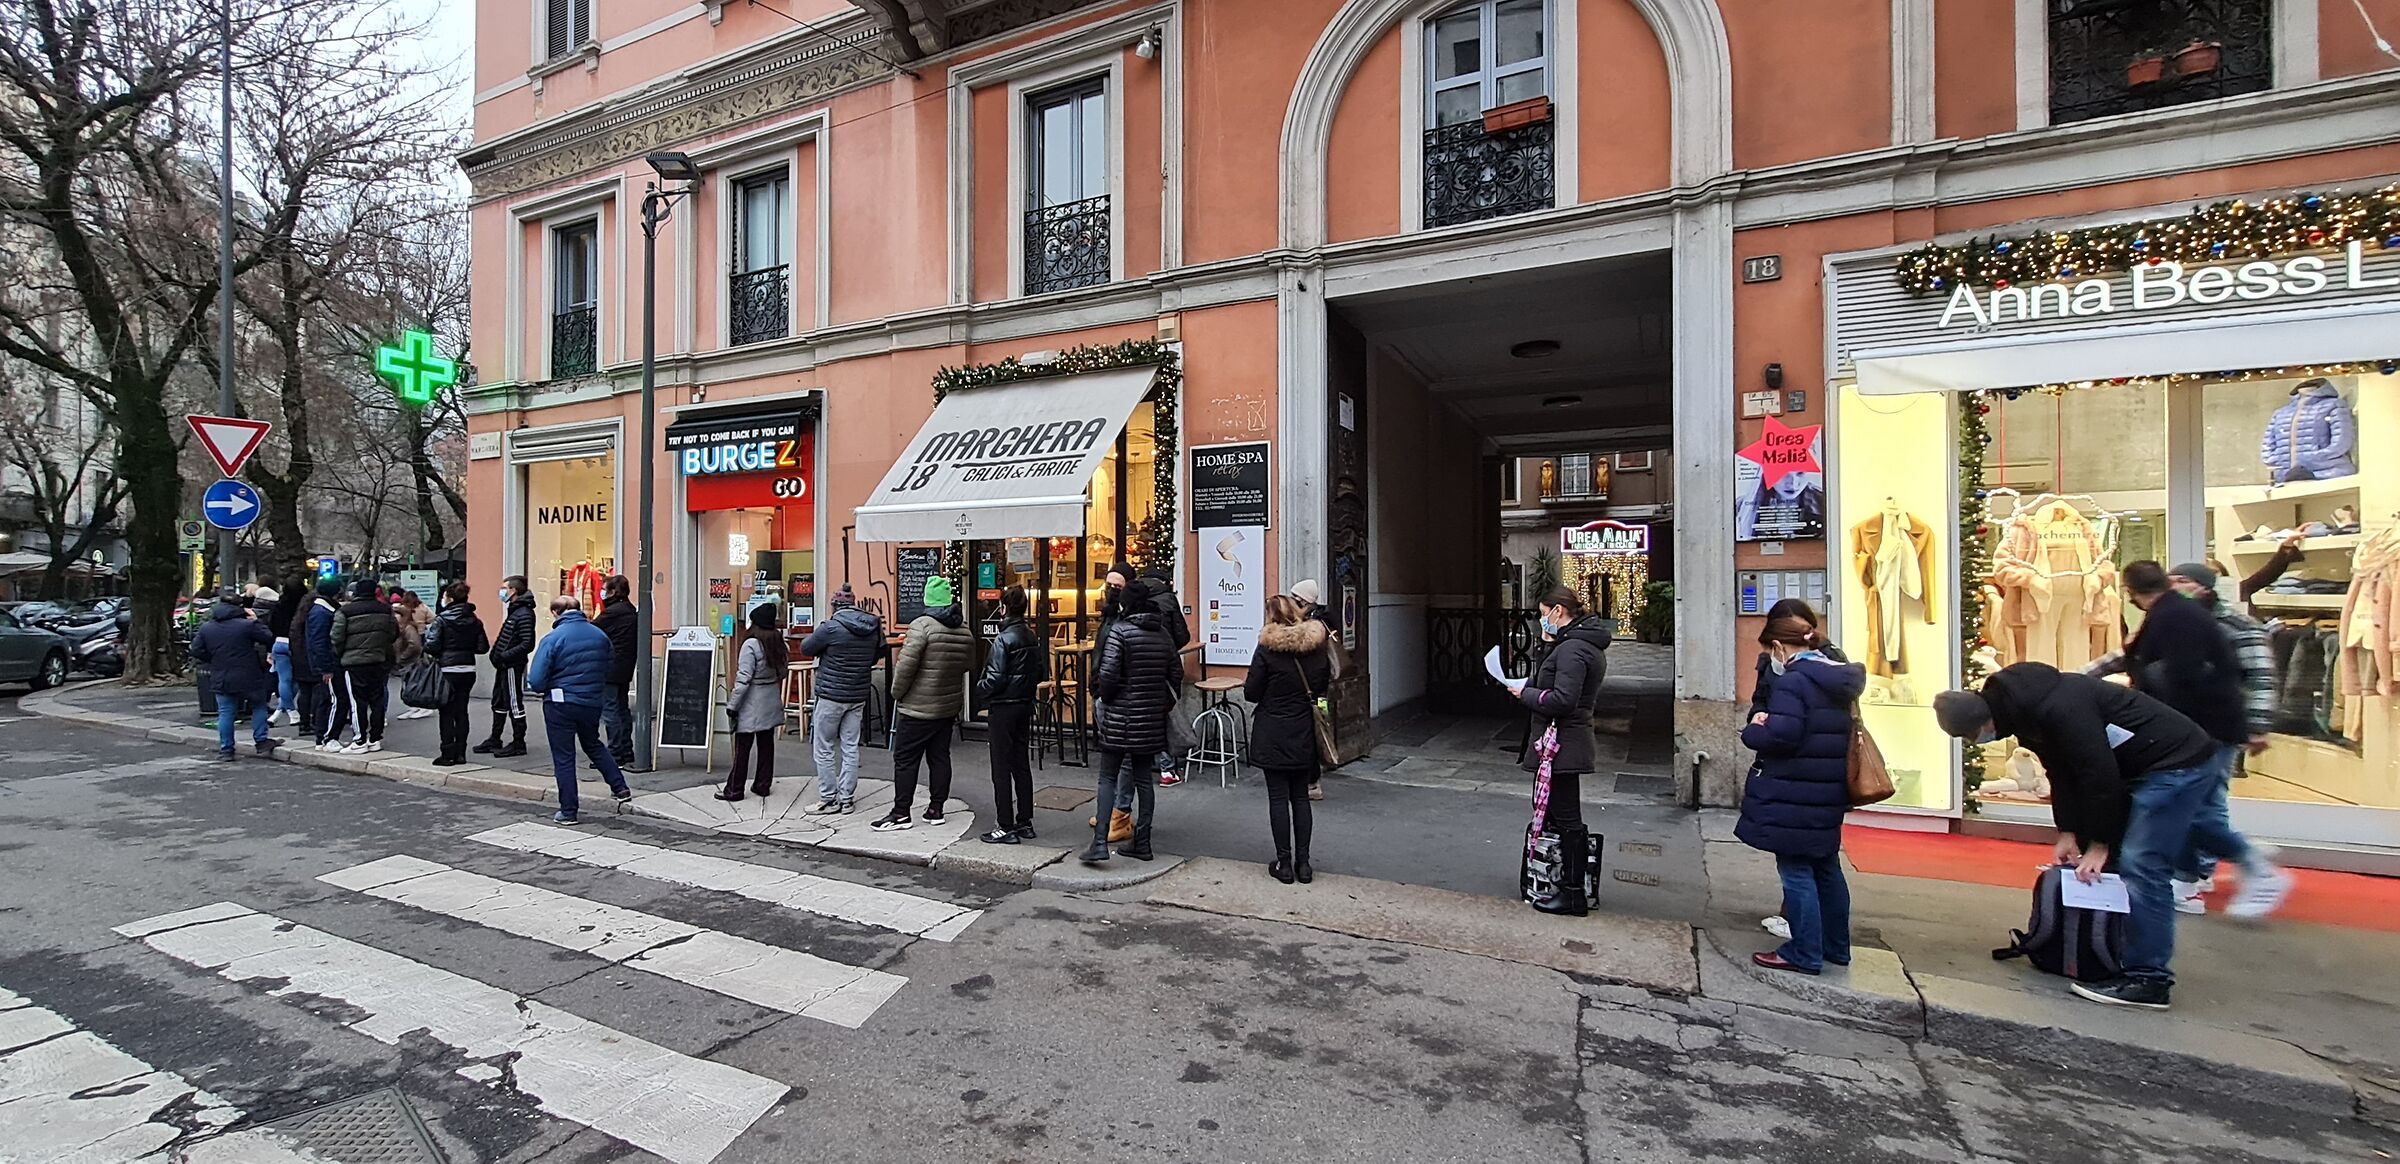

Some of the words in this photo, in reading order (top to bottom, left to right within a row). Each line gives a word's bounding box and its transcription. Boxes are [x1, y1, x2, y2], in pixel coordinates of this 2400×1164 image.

[1746, 258, 1777, 279] 18
[1938, 278, 2115, 329] Anna
[2132, 254, 2327, 310] Bess
[668, 436, 682, 445] TRY
[683, 435, 697, 444] NOT
[700, 434, 709, 443] TO
[710, 432, 730, 442] COME
[731, 430, 750, 440] BACK
[752, 429, 759, 438] IF
[761, 427, 777, 437] YOU
[778, 425, 795, 436] CAN
[914, 417, 1107, 464] MARGHERA
[1766, 432, 1804, 446] Orea
[682, 439, 797, 476] BURGEZ
[1196, 453, 1236, 467] HOME
[1238, 451, 1264, 464] SPA
[891, 462, 939, 493] 18
[962, 464, 1013, 482] CALICI
[1012, 467, 1025, 479] &
[1026, 459, 1082, 478] FARINE
[538, 503, 608, 525] NADINE
[321, 561, 332, 573] P
